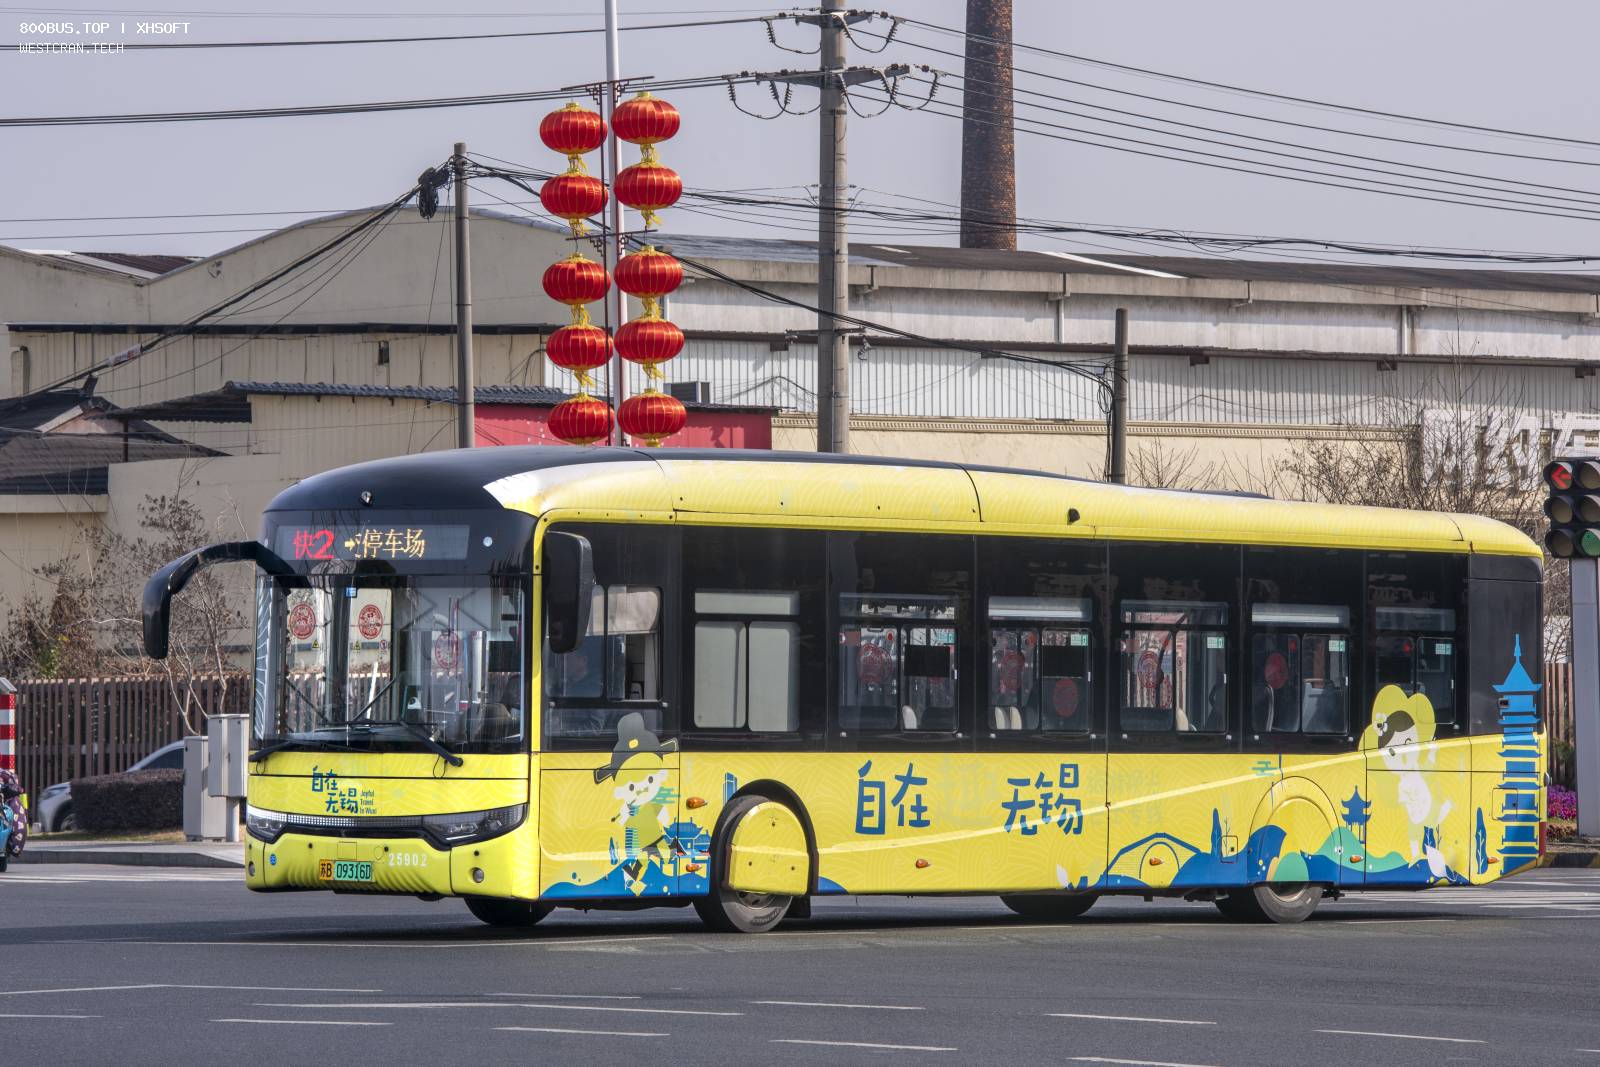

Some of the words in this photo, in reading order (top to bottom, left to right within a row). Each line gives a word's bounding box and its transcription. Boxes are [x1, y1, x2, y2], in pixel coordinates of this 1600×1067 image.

[292, 528, 336, 559] 快2
[312, 765, 338, 792] 自在
[325, 787, 359, 814] 无锡
[855, 759, 931, 835] 自在
[1001, 763, 1084, 836] 无锡
[388, 852, 427, 868] 25902
